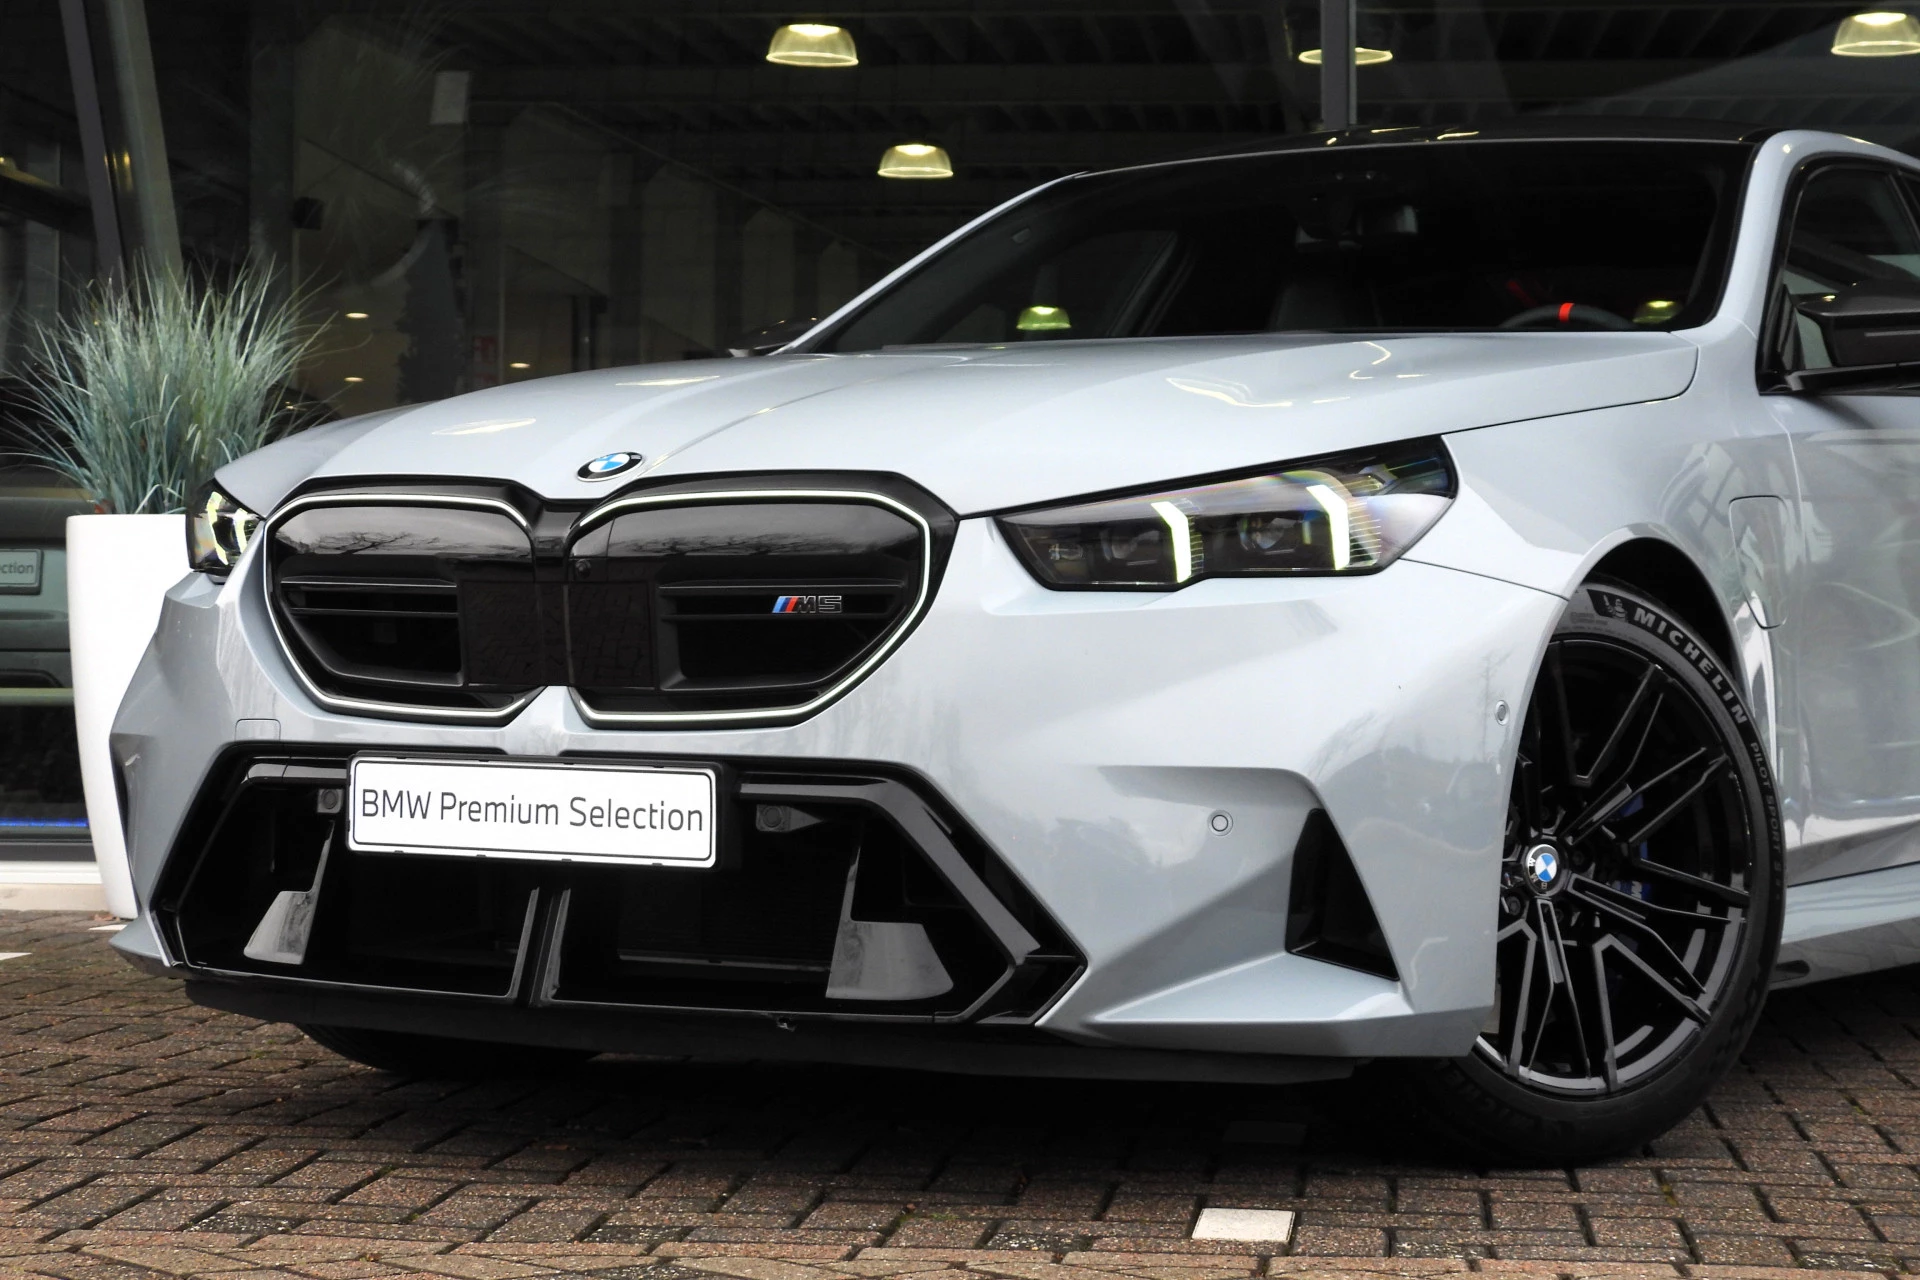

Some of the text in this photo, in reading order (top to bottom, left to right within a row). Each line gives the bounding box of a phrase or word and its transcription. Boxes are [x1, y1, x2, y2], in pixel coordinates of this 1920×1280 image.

[0, 560, 34, 575] ction
[790, 595, 842, 613] M5
[1634, 607, 1747, 724] MICHELIN
[362, 788, 704, 831] BMW Premium Selection
[1750, 742, 1771, 787] PILOT
[1766, 796, 1782, 853] SPORT
